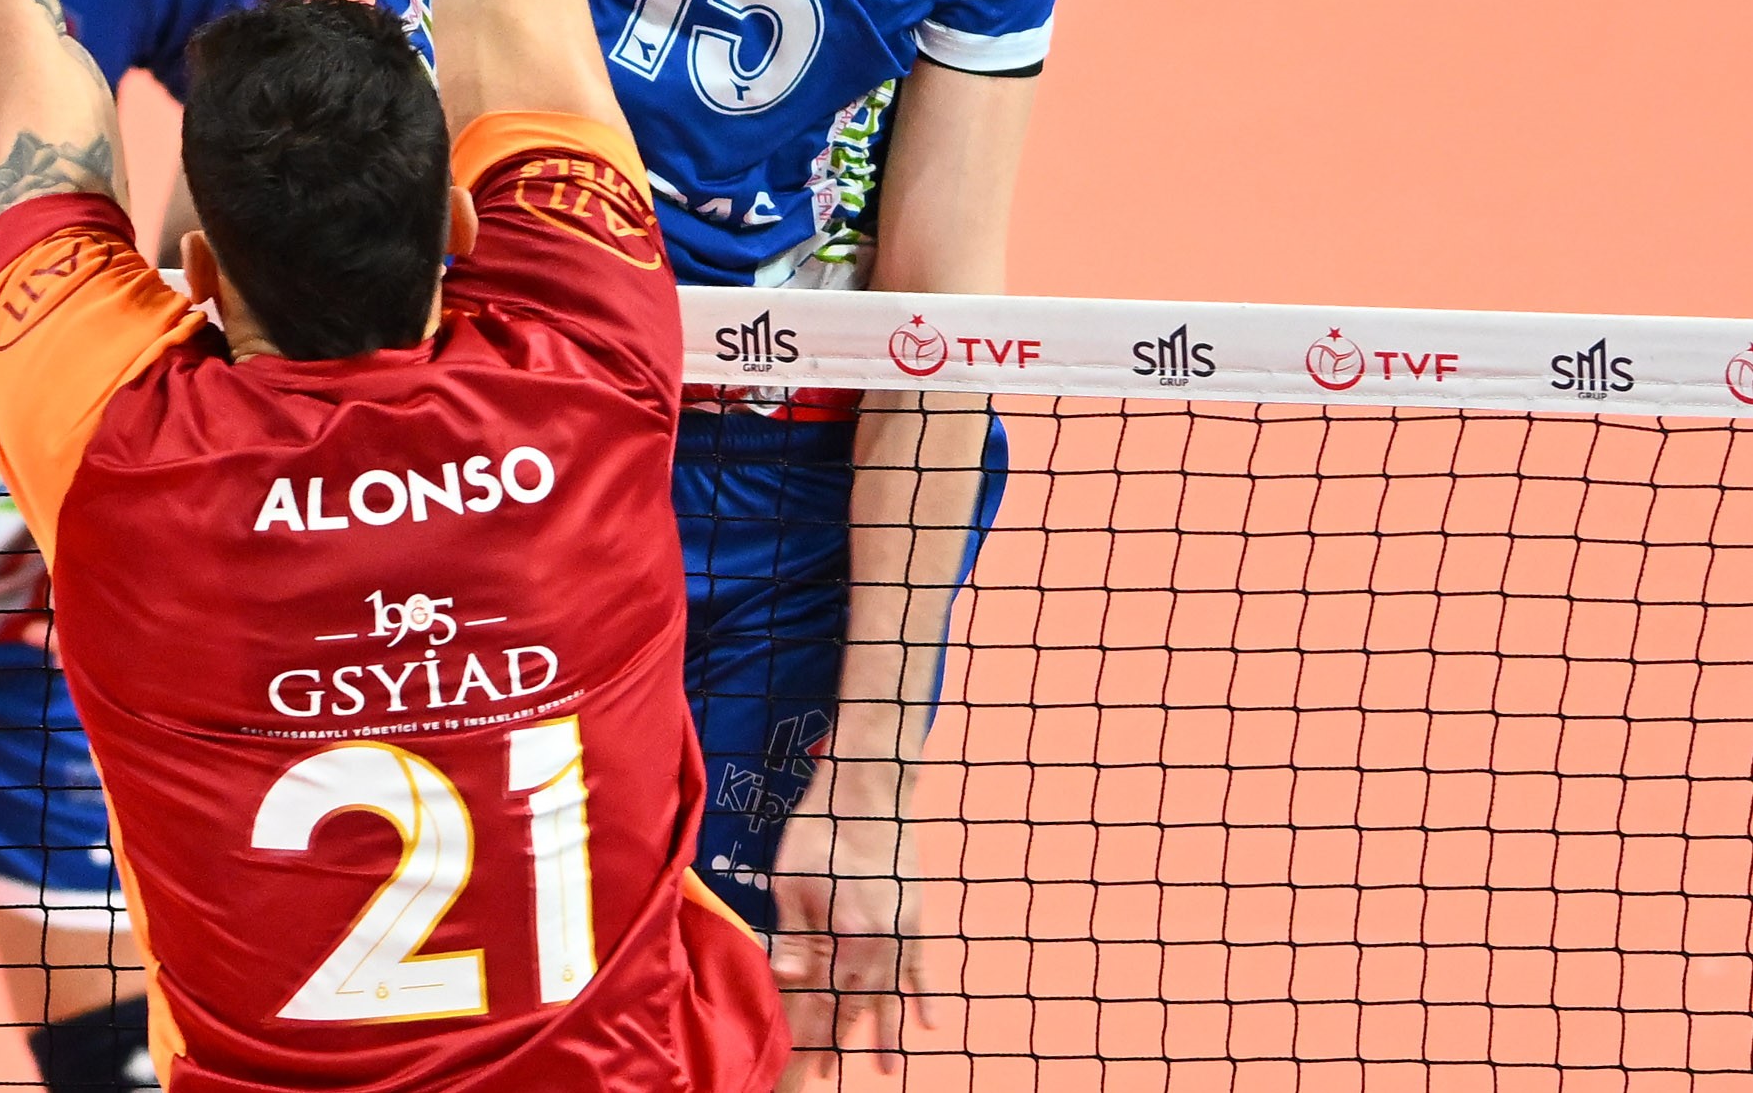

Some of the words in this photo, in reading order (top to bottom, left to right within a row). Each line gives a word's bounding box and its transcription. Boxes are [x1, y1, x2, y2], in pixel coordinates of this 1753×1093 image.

[716, 309, 799, 363] SMS
[956, 337, 1042, 369] TVF
[1132, 323, 1215, 378] SMS
[742, 363, 773, 373] GRUP
[1159, 377, 1189, 387] GRUP
[1374, 350, 1459, 382] TVF
[1551, 337, 1635, 392] SMS
[1578, 391, 1608, 400] GRUP
[253, 446, 555, 531] ALONSO
[268, 646, 559, 719] GSYİAD
[422, 721, 440, 731] VE
[251, 714, 597, 1024] 21
